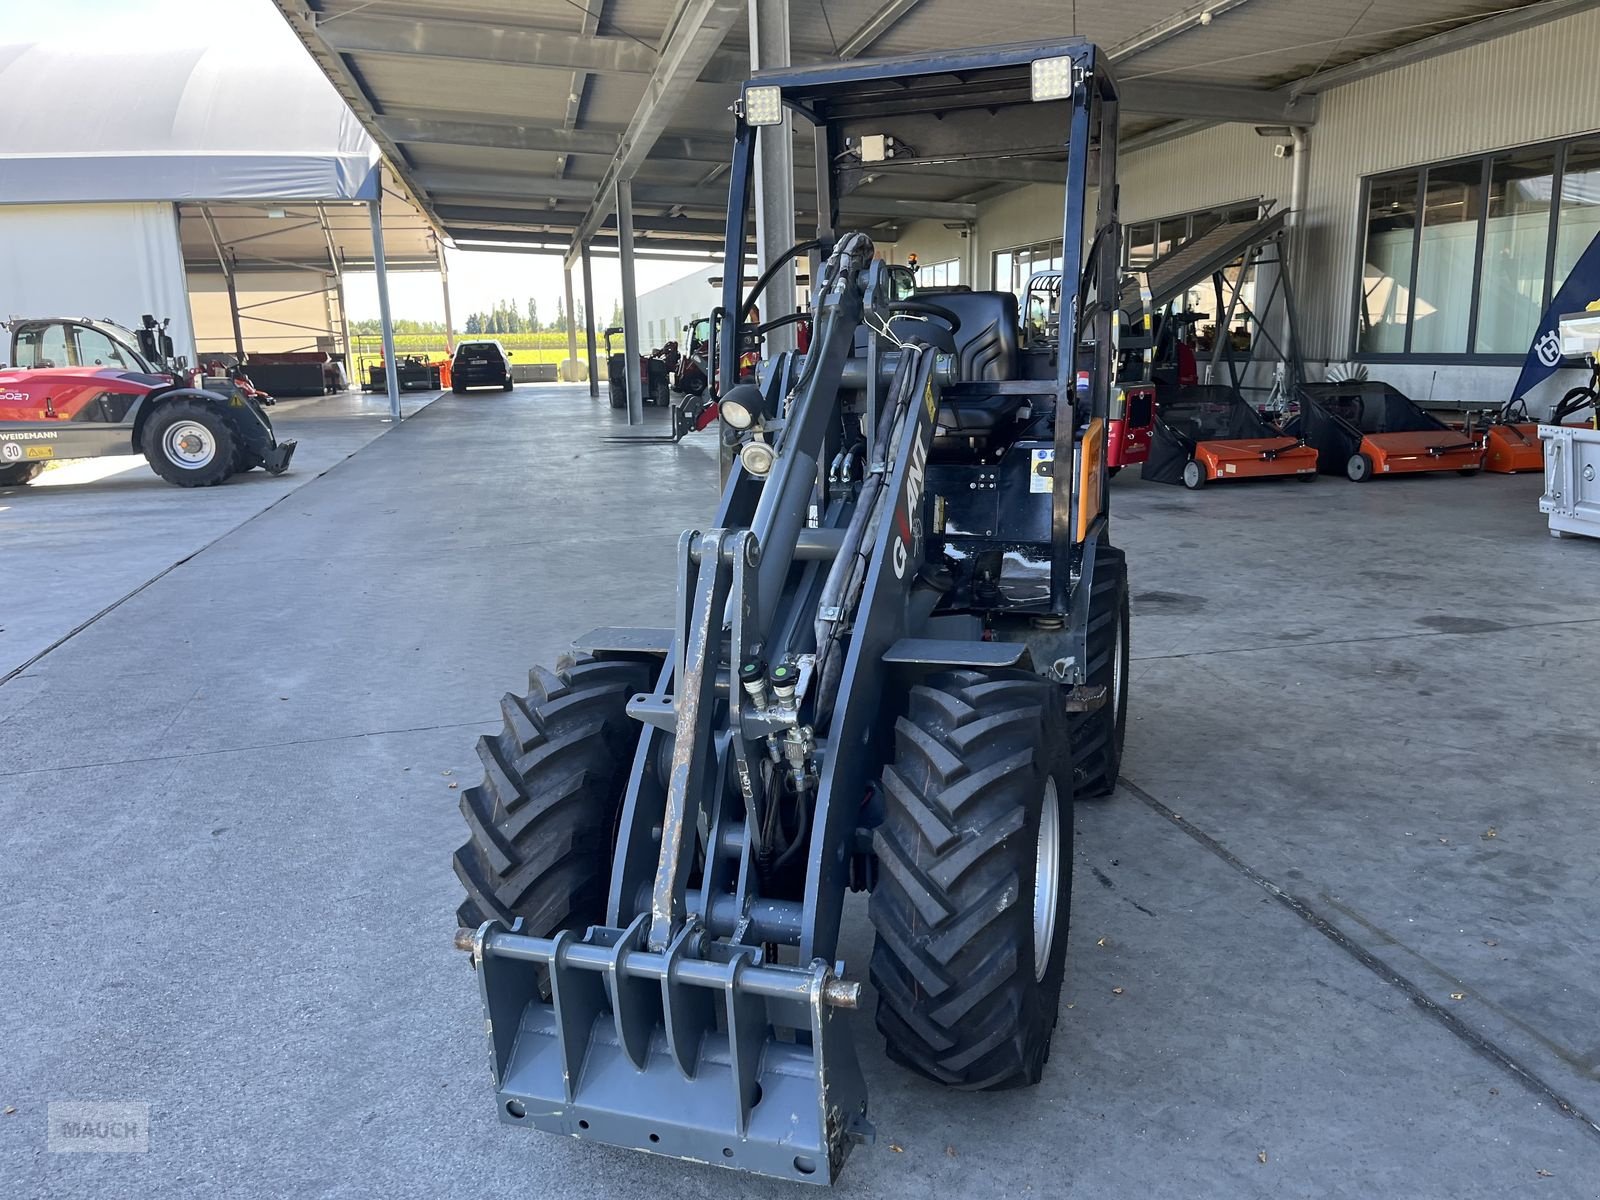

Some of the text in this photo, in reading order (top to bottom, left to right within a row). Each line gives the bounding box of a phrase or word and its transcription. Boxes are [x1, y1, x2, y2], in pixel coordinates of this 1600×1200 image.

[0, 432, 57, 440] WEIDEMANN
[6, 446, 19, 457] 30
[893, 421, 927, 579] GIANT
